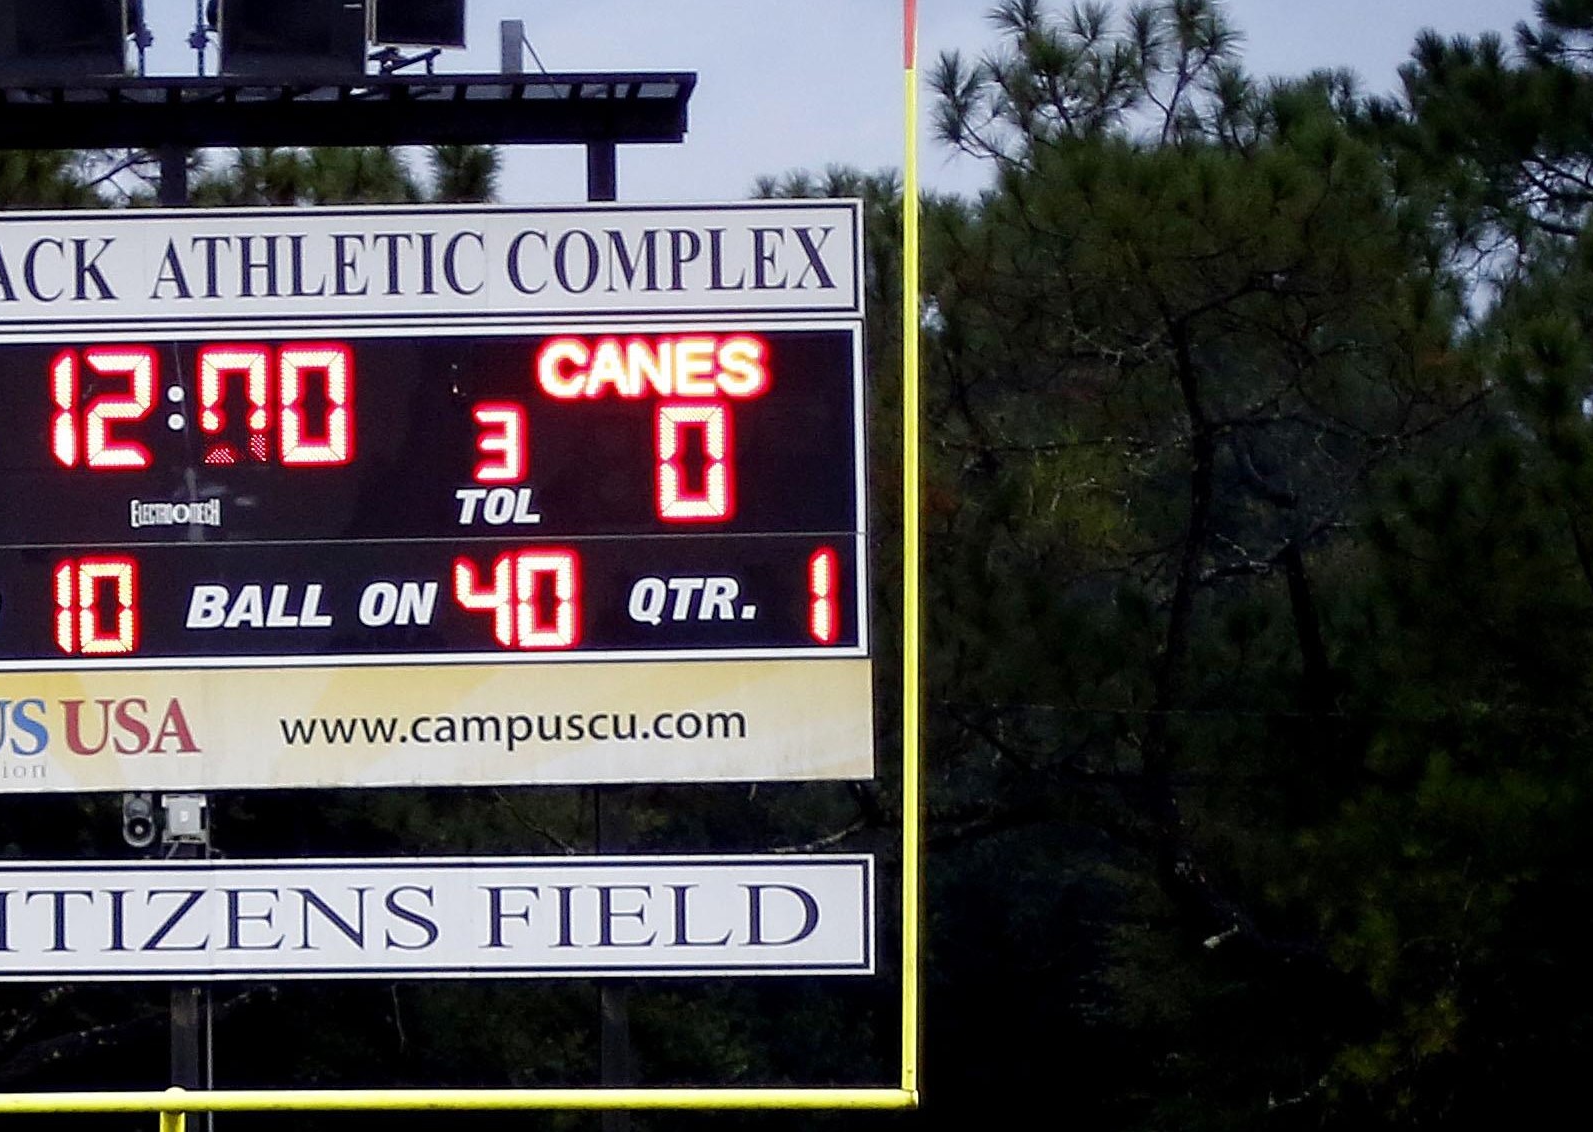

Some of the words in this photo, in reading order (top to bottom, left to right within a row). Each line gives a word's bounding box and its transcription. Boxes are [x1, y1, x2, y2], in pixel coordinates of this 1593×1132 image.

[150, 230, 486, 301] ATHLETIC
[506, 226, 839, 294] COMPLEX
[538, 339, 767, 397] CANES
[473, 408, 518, 481] 3
[657, 404, 727, 518] 0
[455, 487, 542, 525] TOL
[56, 561, 136, 656] 10
[185, 583, 334, 629] BALL
[357, 580, 439, 626] ON
[453, 554, 577, 649] 40
[626, 576, 759, 625] QTR.
[808, 551, 833, 644] 1
[60, 697, 202, 756] USA
[279, 708, 747, 752] www.campuscu.com
[479, 882, 821, 950] FIELD
